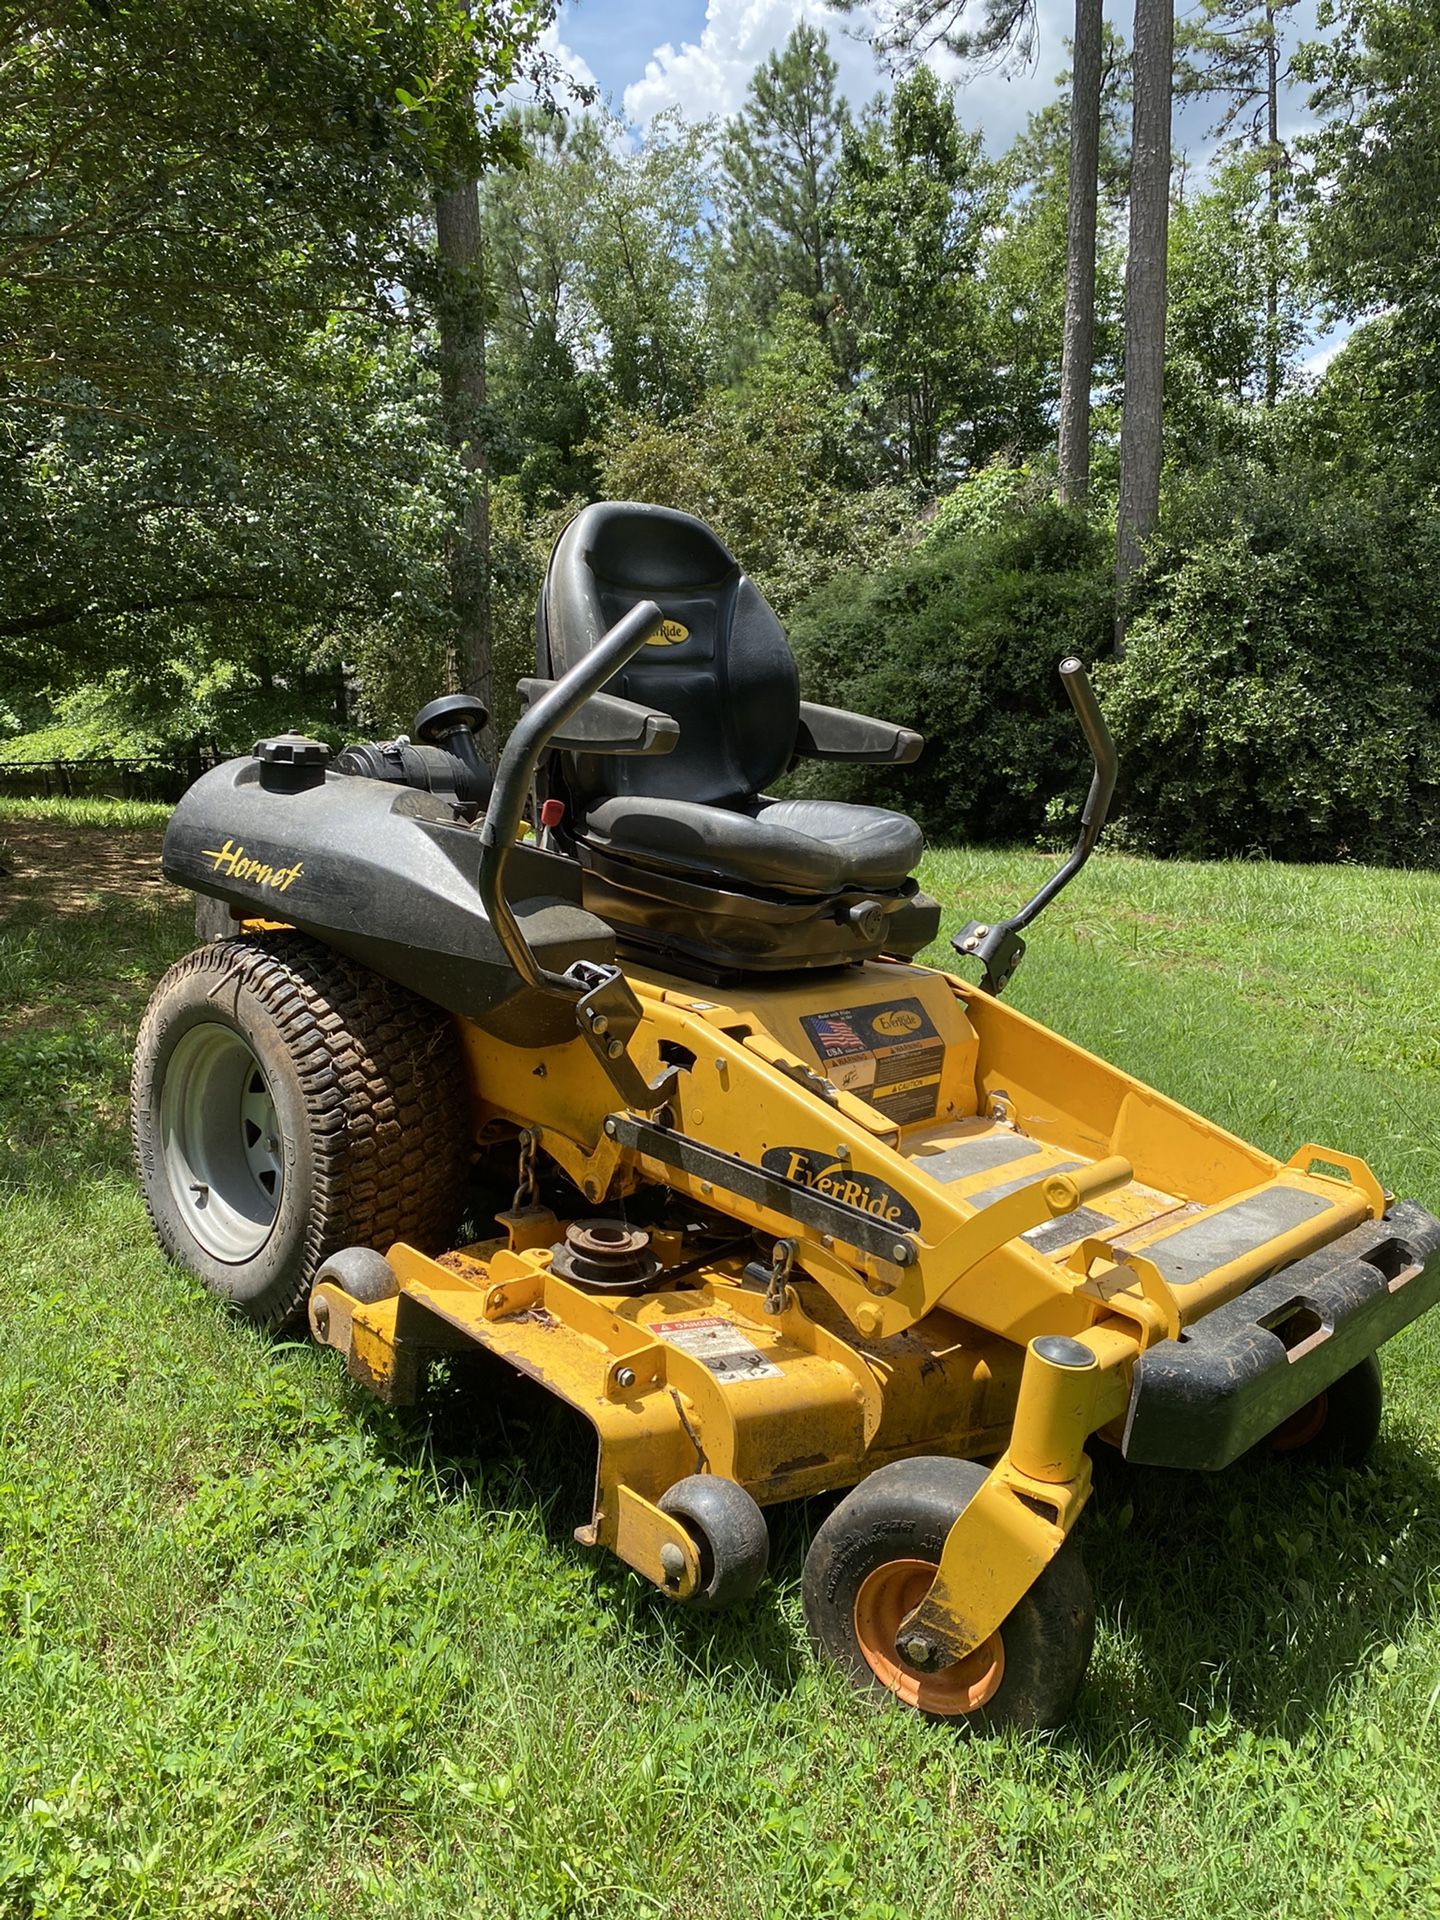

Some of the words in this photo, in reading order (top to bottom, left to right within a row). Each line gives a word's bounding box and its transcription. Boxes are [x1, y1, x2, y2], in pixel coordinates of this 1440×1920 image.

[201, 840, 304, 892] Hornet
[880, 1013, 917, 1030] EverRide
[826, 1047, 844, 1058] USA
[895, 1041, 923, 1054] WARNING
[838, 1053, 868, 1068] WARNING
[898, 1079, 923, 1091] CAUTION
[786, 1151, 901, 1224] EverRide
[674, 1319, 720, 1329] DANGER
